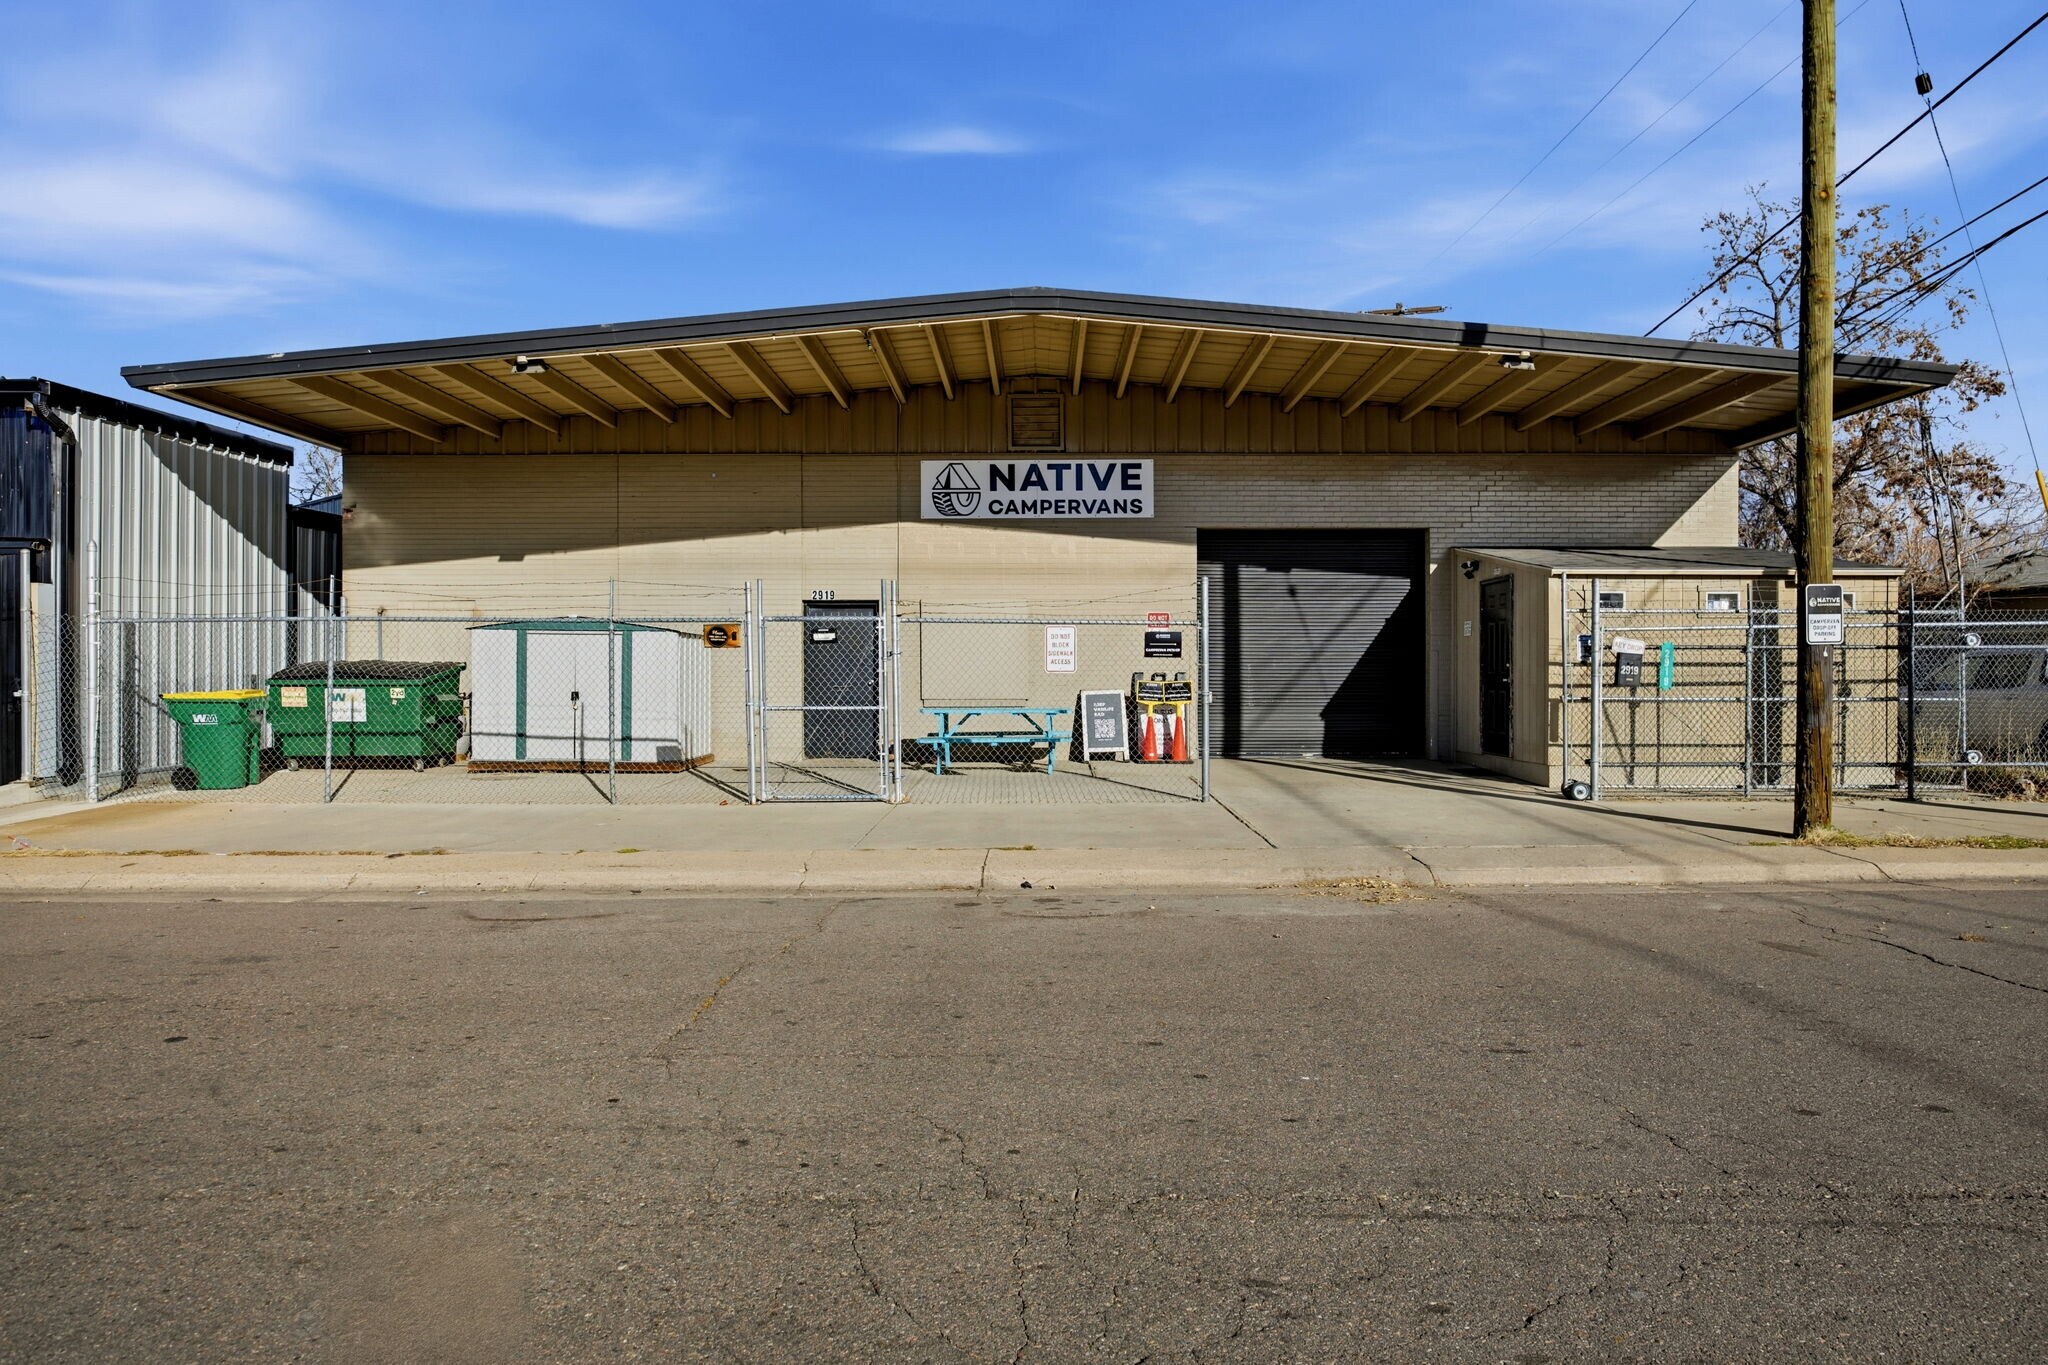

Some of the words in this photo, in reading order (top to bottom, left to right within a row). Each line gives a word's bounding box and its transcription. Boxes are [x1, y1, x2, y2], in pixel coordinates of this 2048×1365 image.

[988, 463, 1143, 492] NATIVE
[988, 499, 1143, 515] CAMPERVANS
[812, 590, 835, 600] 2919
[1620, 665, 1639, 675] 2919
[192, 714, 218, 723] WM
